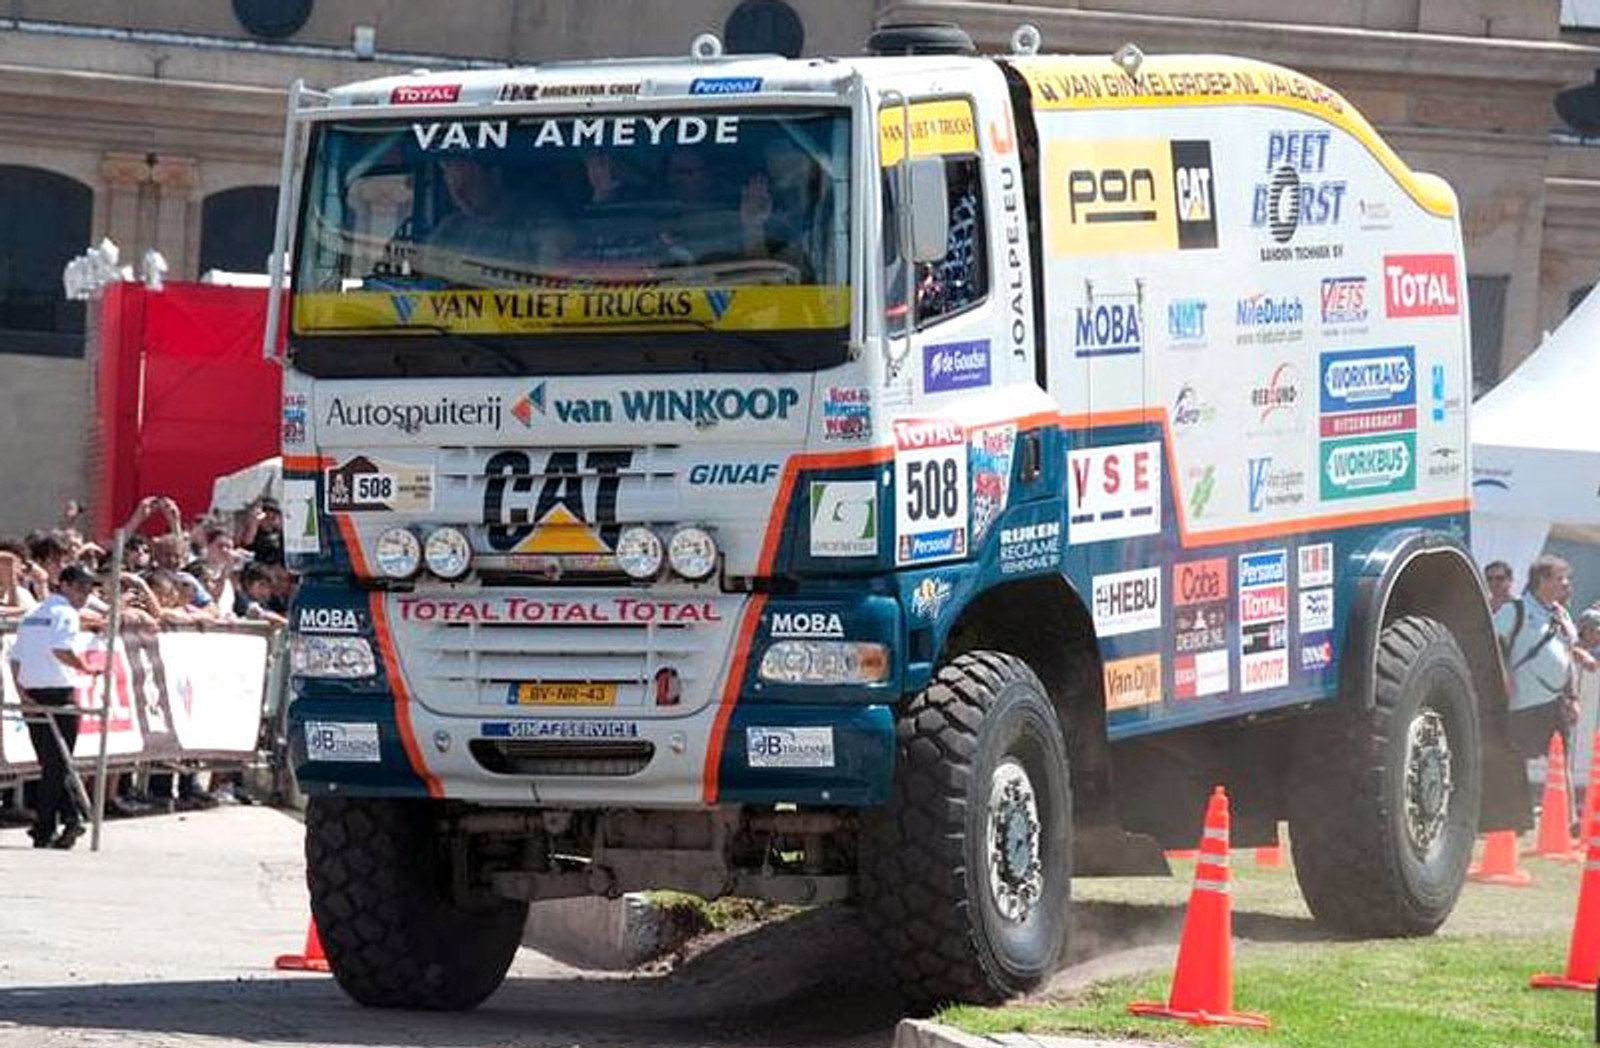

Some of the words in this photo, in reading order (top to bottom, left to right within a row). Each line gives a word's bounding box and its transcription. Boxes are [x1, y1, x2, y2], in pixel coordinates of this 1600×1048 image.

[398, 86, 455, 102] TOTAL
[692, 78, 758, 94] Personal
[1061, 74, 1101, 98] VAN
[413, 121, 508, 150] VAN
[534, 116, 739, 148] AMEYDE
[1266, 130, 1332, 174] PEET
[1068, 167, 1157, 225] pon
[1175, 165, 1212, 222] CAT
[1000, 167, 1027, 362] JOALPE.EU
[1387, 265, 1456, 309] TOTAL
[430, 295, 484, 320] VAN
[493, 293, 567, 319] VLIET
[580, 290, 693, 318] TRUCKS
[1236, 296, 1304, 326] NileDutch
[1076, 303, 1140, 350] MOBA
[1331, 362, 1406, 389] WORKTRANS
[326, 397, 502, 432] Autospuiterij
[554, 400, 613, 423] van
[620, 388, 799, 423] WINKOOP
[897, 423, 963, 446] TOTAL
[689, 463, 779, 485] GINAF
[1333, 445, 1405, 478] WORKBUS
[359, 477, 392, 499] 508
[484, 449, 634, 554] CAT
[907, 457, 959, 522] 508
[1109, 576, 1158, 616] HEBU
[1181, 566, 1220, 602] Coba
[300, 609, 357, 627] MOBA
[397, 598, 500, 621] TOTAL
[505, 598, 609, 621] TOTAL
[611, 599, 722, 621] TOTAL
[1243, 592, 1286, 619] TOTAL
[772, 613, 843, 633] MOBA
[529, 686, 606, 701] BV-NR-43
